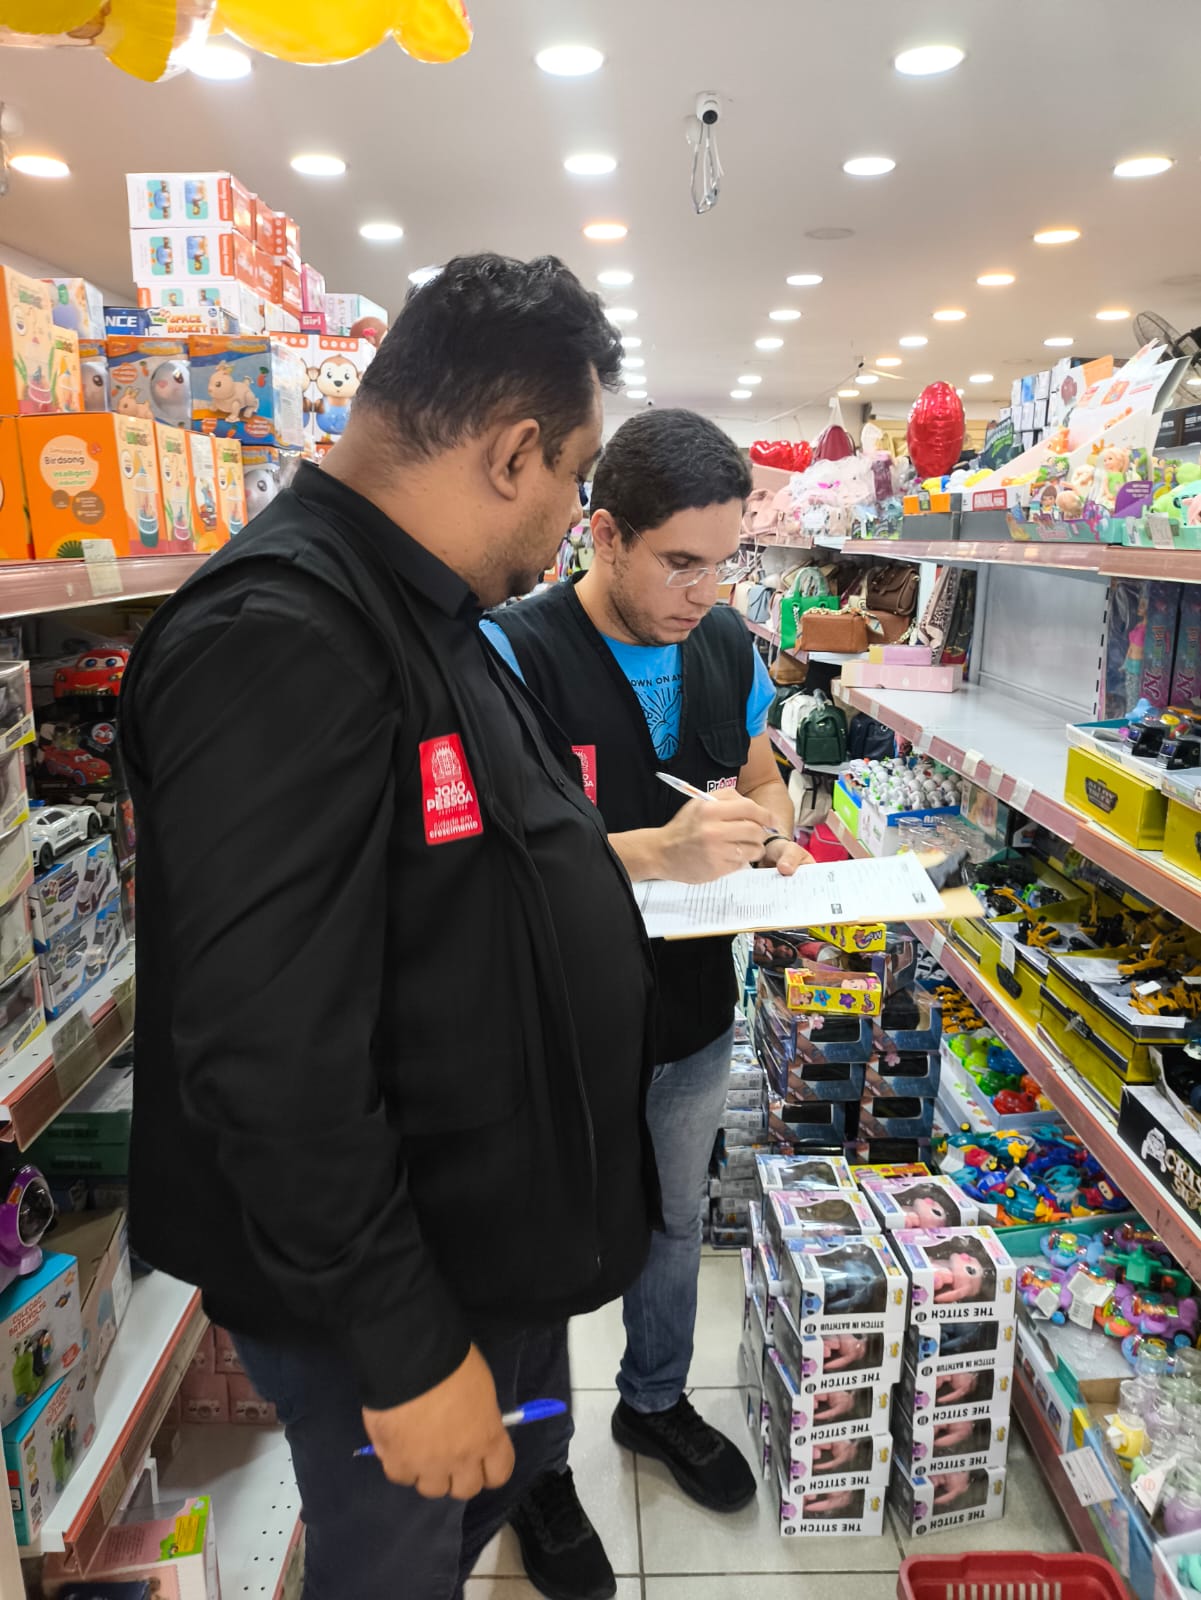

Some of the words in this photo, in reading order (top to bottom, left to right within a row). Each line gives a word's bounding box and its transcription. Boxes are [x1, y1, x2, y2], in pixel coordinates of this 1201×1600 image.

[169, 314, 202, 324] SPACE
[167, 324, 208, 334] ROCKET
[44, 456, 85, 465] Birdsong
[655, 676, 670, 684] ON
[434, 780, 465, 796] JOÃO
[426, 790, 473, 812] PESSOA
[931, 1308, 969, 1319] STITCH
[974, 1307, 994, 1317] THE
[820, 1321, 850, 1331] BATHTUB
[852, 1321, 859, 1329] IN
[861, 1320, 885, 1329] STITCH
[936, 1361, 964, 1372] BATHTUB
[965, 1360, 972, 1368] IN
[973, 1358, 995, 1367] STITCH
[862, 1372, 880, 1381] THE
[820, 1376, 858, 1389] STITCH
[932, 1408, 968, 1421] STITCH
[972, 1405, 991, 1414] THE
[851, 1423, 870, 1431] THE
[810, 1427, 847, 1440] STITCH
[930, 1459, 966, 1471] STITCH
[969, 1456, 988, 1464] THE
[809, 1478, 847, 1490] STITCH
[968, 1509, 986, 1520] THE
[841, 1523, 862, 1532] THE
[929, 1516, 964, 1529] STITCH
[800, 1524, 838, 1532] STITCH
